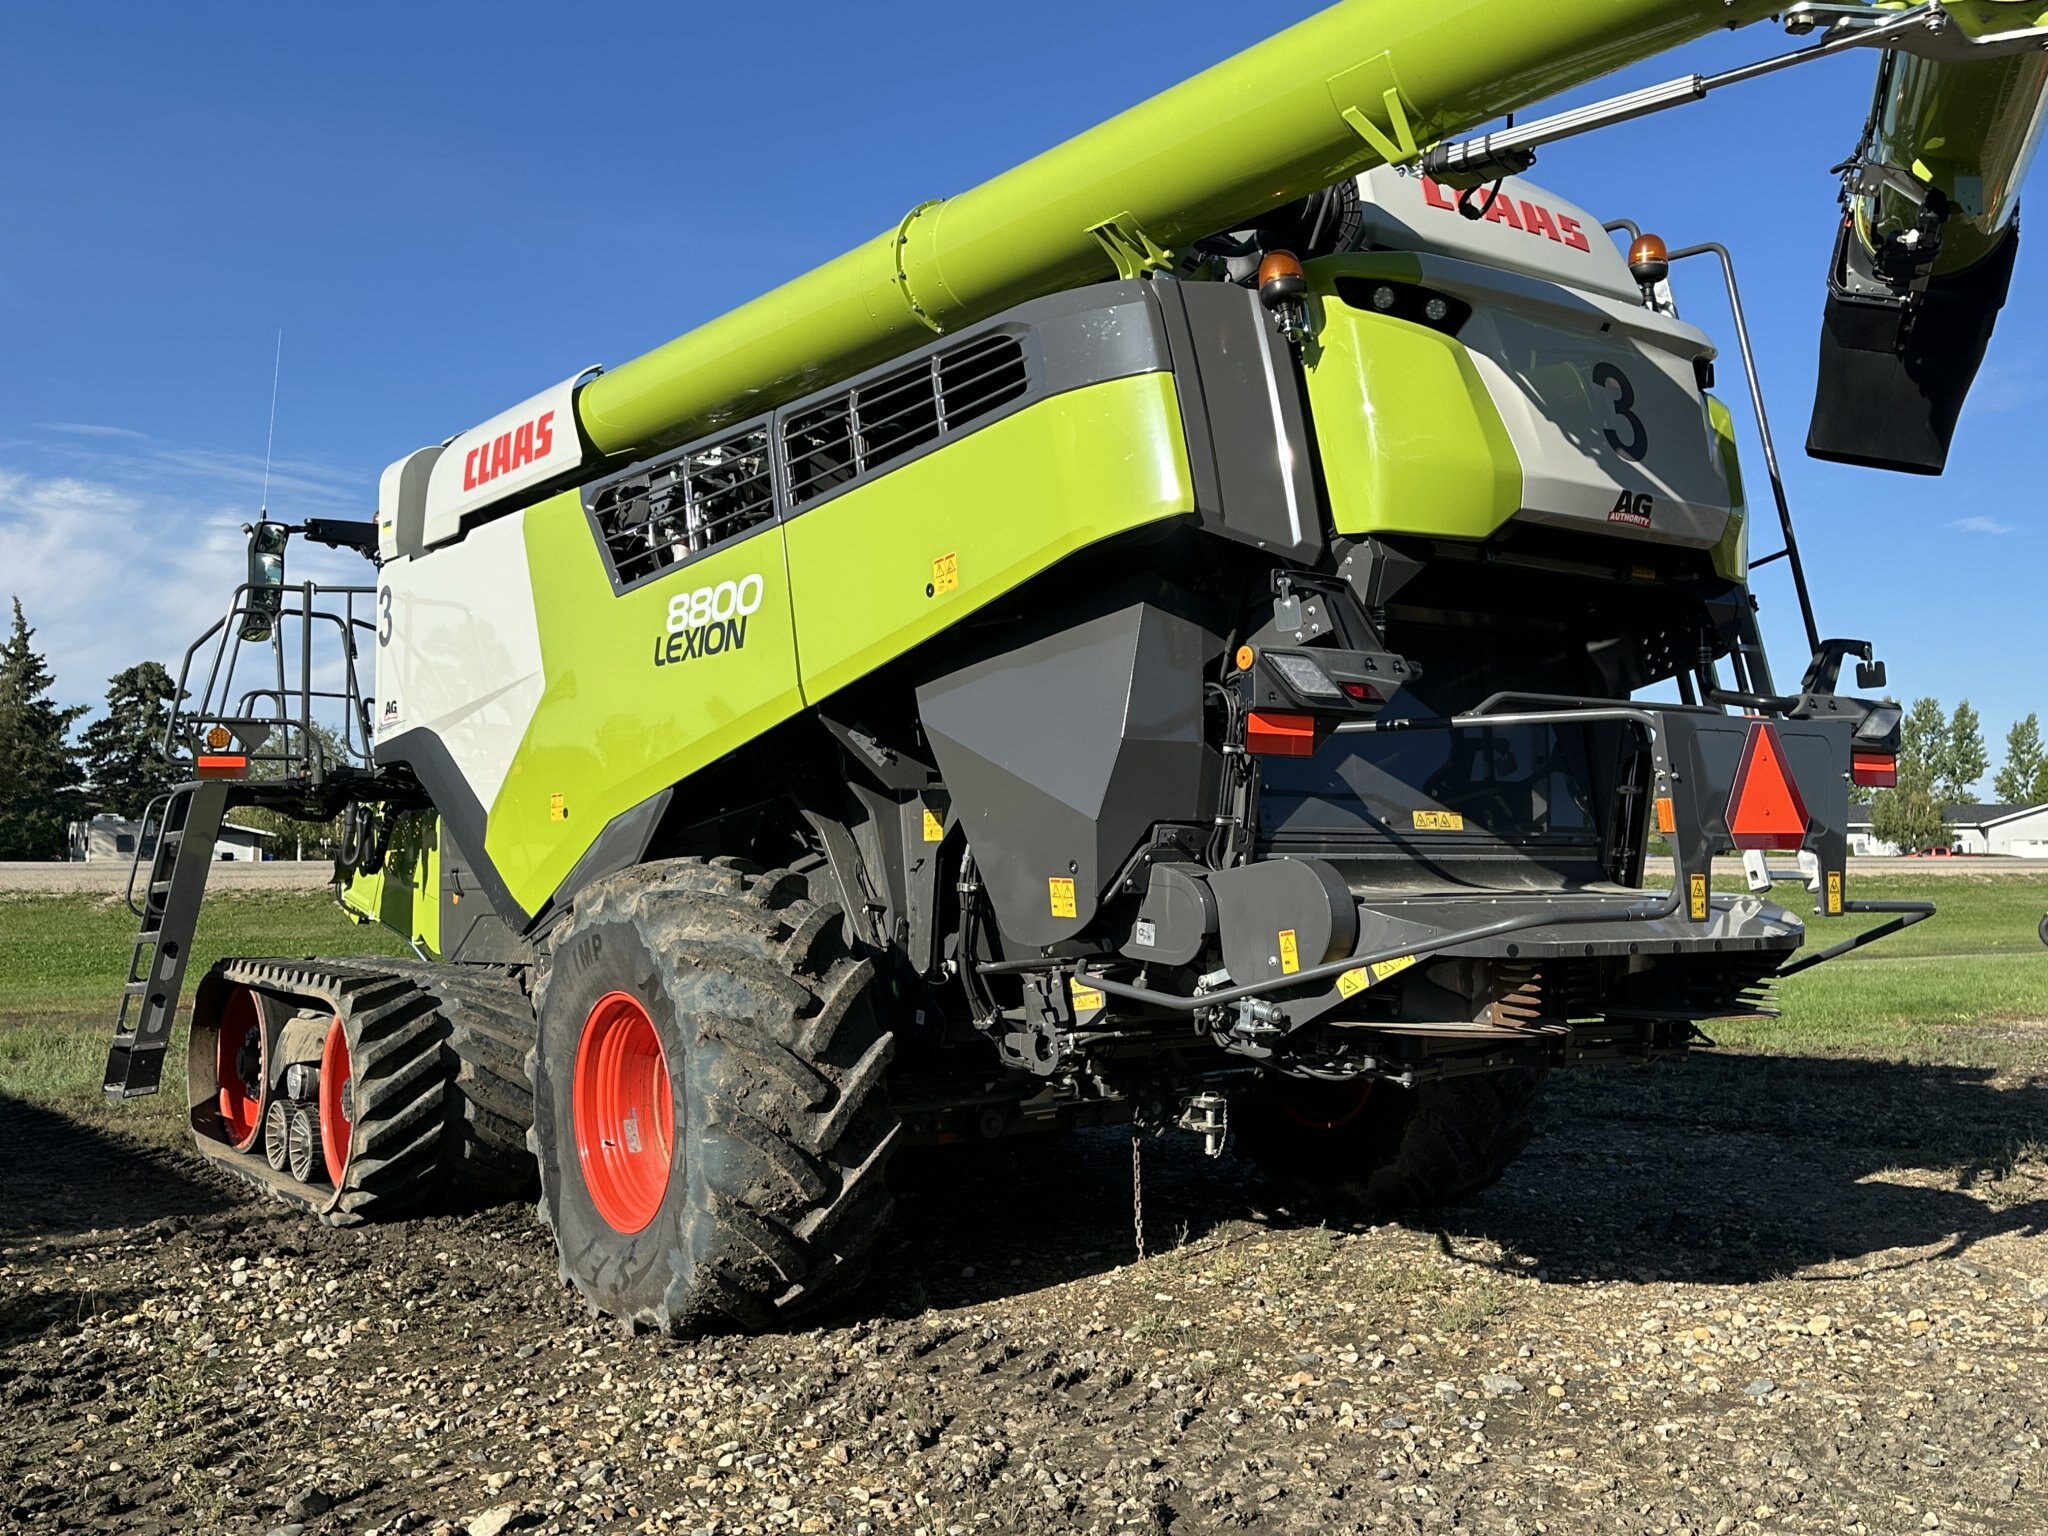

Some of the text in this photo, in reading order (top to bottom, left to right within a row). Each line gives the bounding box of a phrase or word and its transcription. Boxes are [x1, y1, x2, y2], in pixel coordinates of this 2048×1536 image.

[1592, 361, 1648, 462] 3
[464, 410, 554, 492] CLAAS
[1609, 512, 1650, 526] AUTHORITY
[1613, 489, 1653, 518] AG
[378, 584, 393, 648] 3
[666, 573, 764, 634] 8800
[654, 615, 747, 667] LEXION
[385, 700, 397, 715] AG
